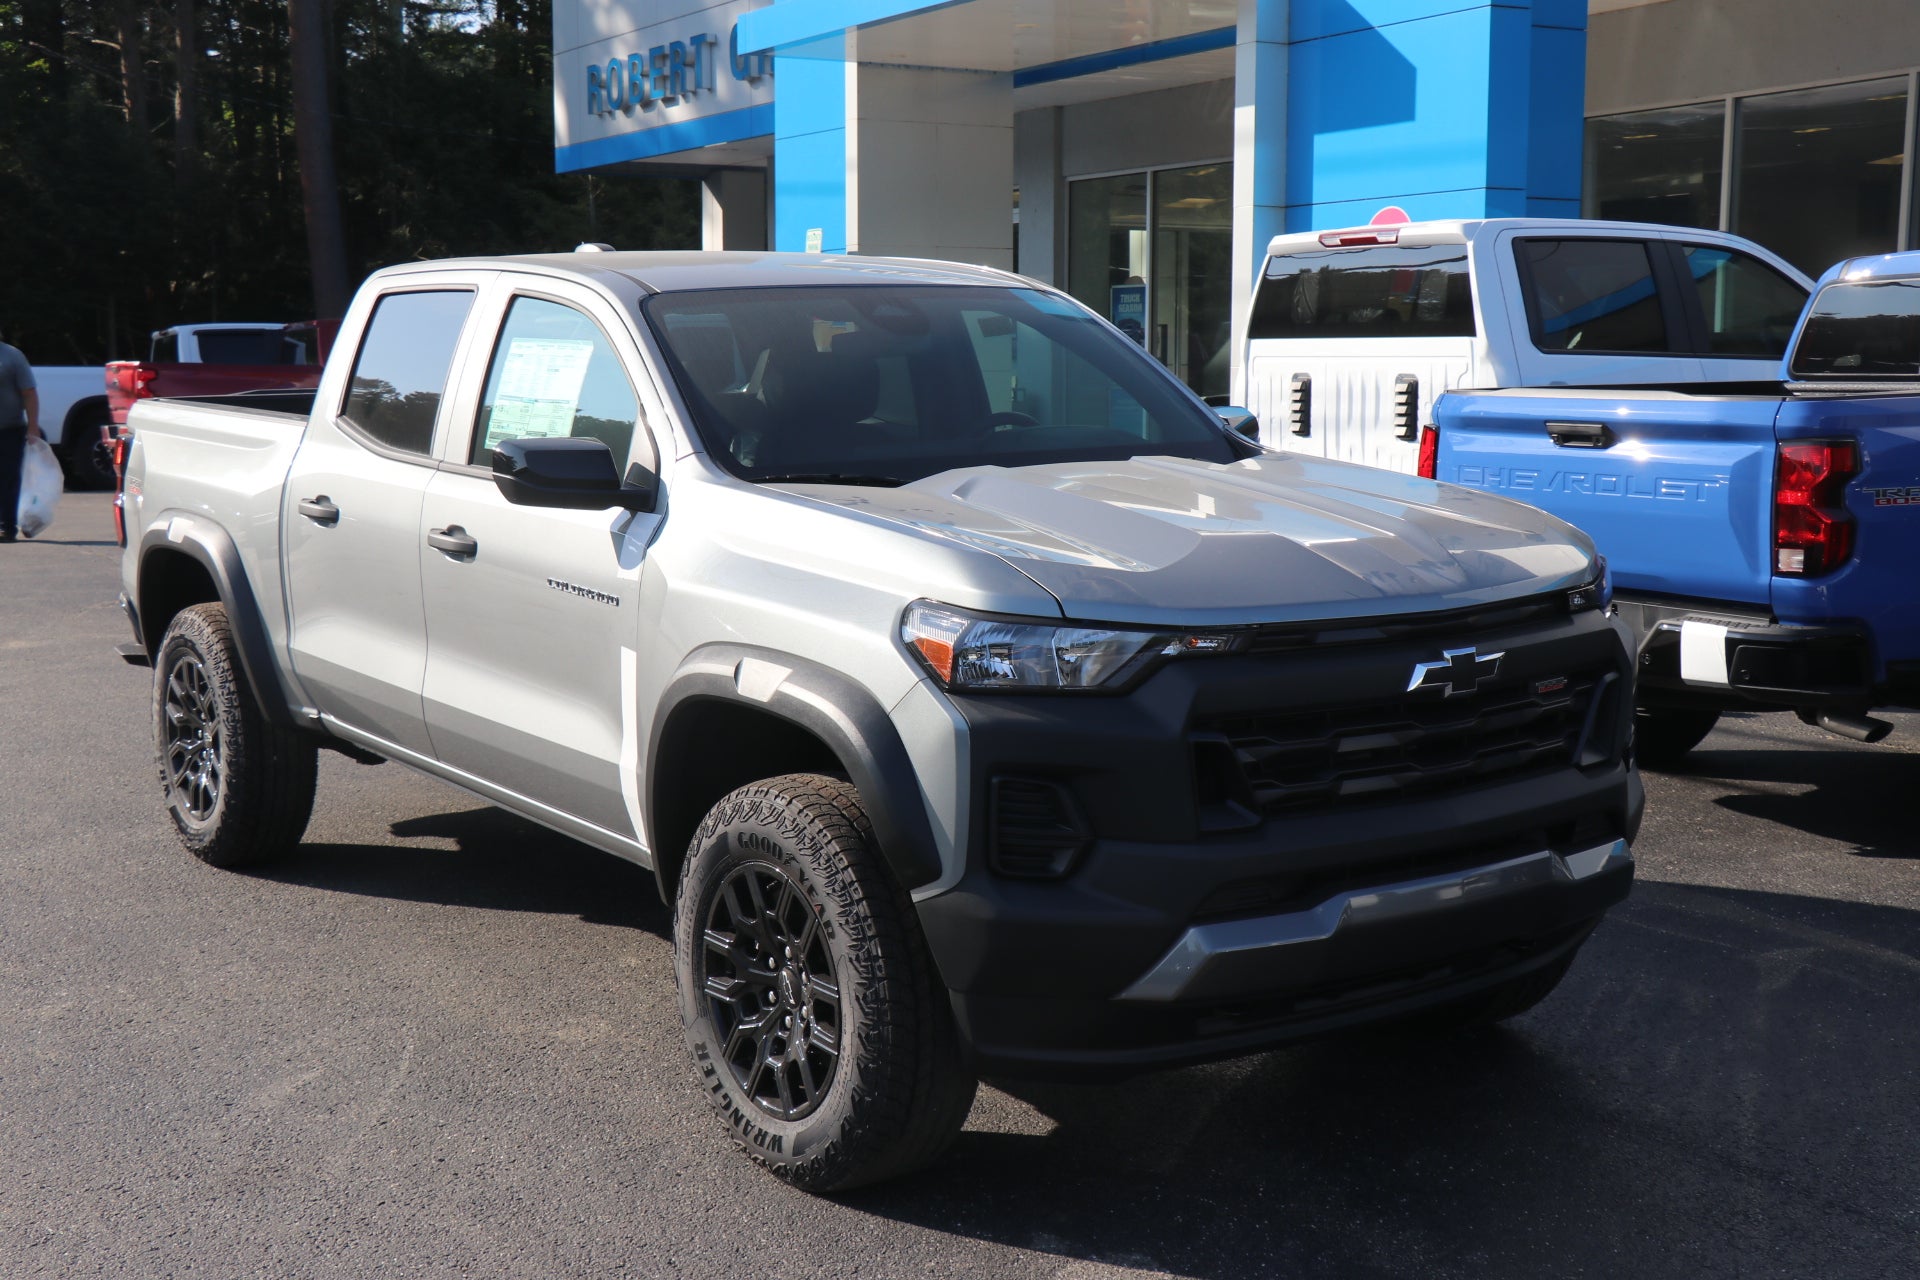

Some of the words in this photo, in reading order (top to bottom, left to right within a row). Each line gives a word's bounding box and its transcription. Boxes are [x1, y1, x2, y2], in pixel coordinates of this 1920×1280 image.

[587, 33, 716, 115] ROBERT
[1118, 303, 1143, 313] SEASON
[1120, 294, 1141, 303] TRUCK
[1457, 464, 1724, 502] CHEVROLET
[694, 1041, 784, 1155] WRANGLER
